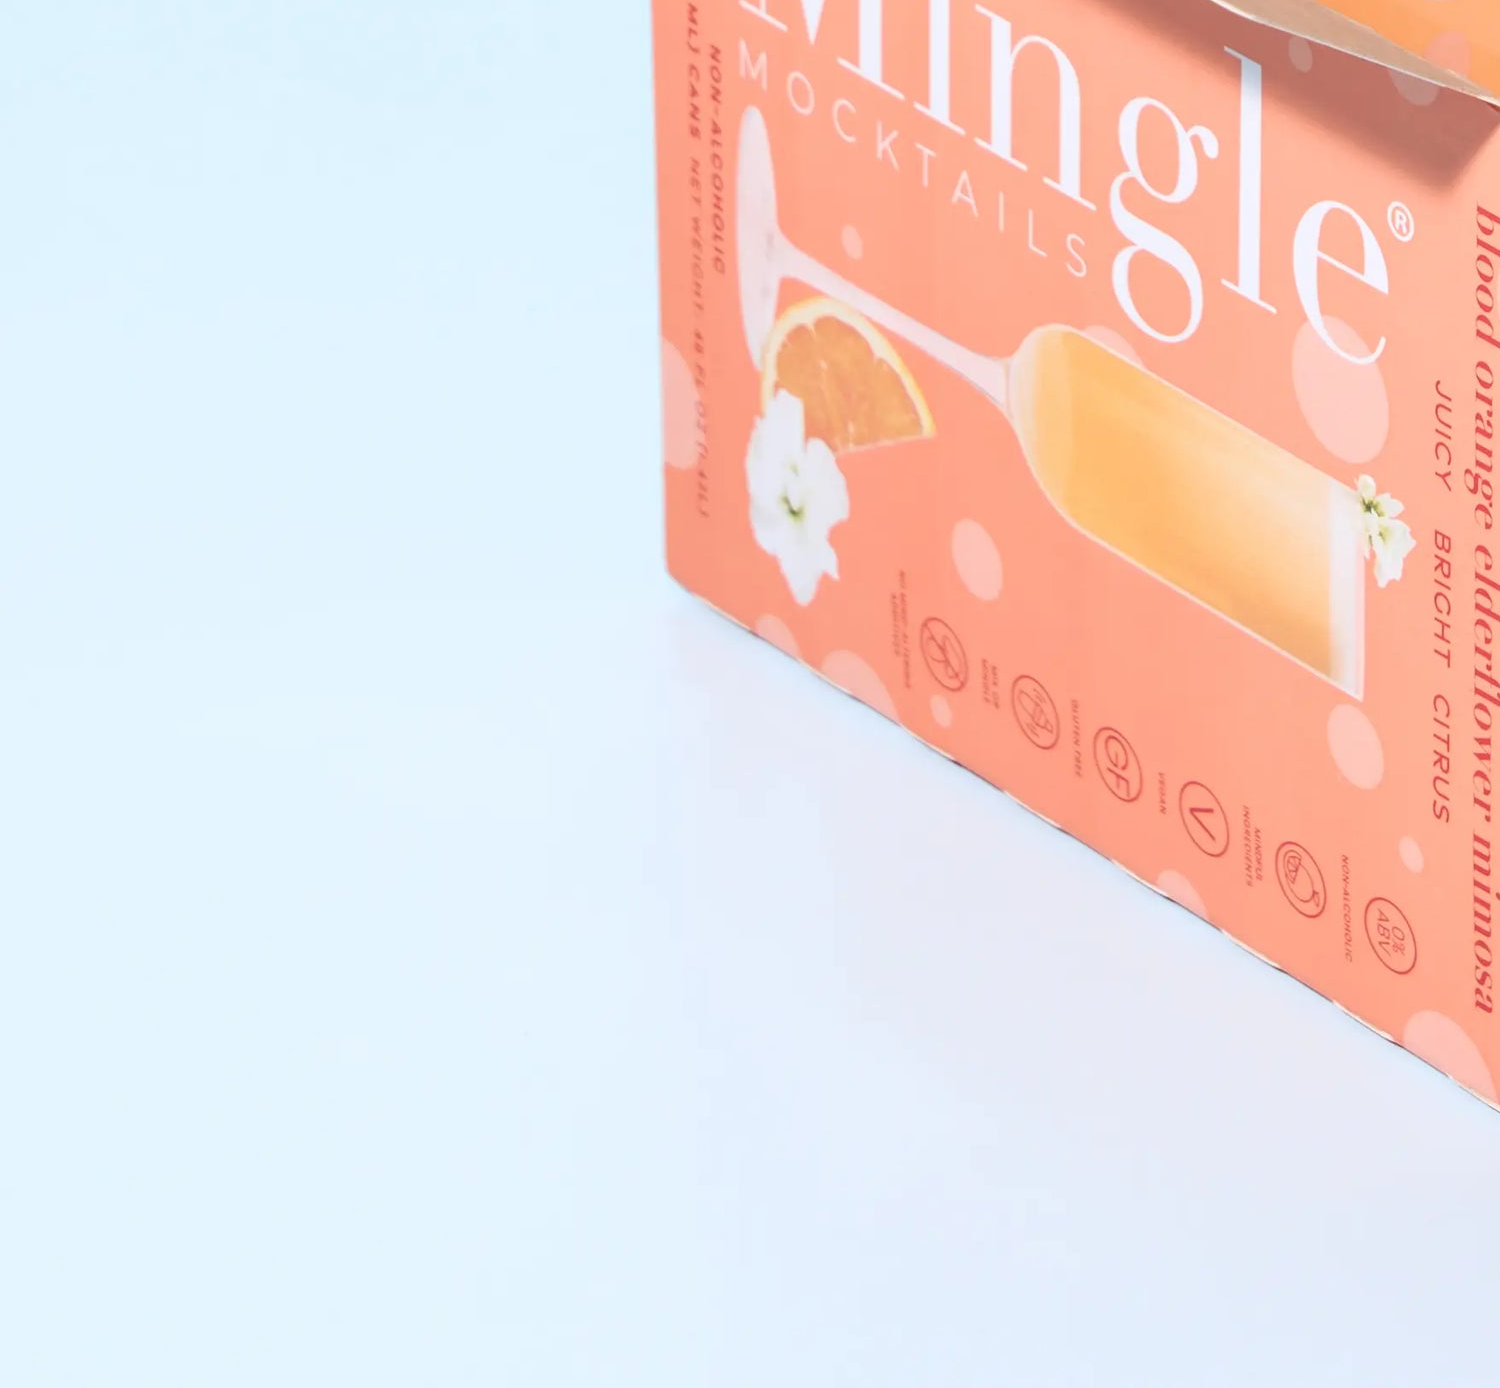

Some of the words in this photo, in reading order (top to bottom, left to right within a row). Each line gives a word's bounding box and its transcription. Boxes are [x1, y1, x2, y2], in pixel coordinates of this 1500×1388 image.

[688, 63, 702, 143] CANS
[709, 43, 728, 276] NON-ALCOHOLIC
[739, 38, 1089, 278] MOCKTAILS
[1435, 379, 1454, 493] JUICY
[1466, 359, 1495, 531] orange
[1432, 529, 1453, 670] BRIGHT
[1104, 734, 1131, 799] GF
[1432, 693, 1452, 825] CITRUS
[1188, 806, 1216, 843] V
[1242, 806, 1254, 888] INGREDIENTS
[1253, 827, 1264, 882] MINDFUL
[1341, 854, 1354, 963] NON-ALCOHOLIC
[1375, 906, 1392, 958] ABV
[1391, 925, 1406, 958] 0%
